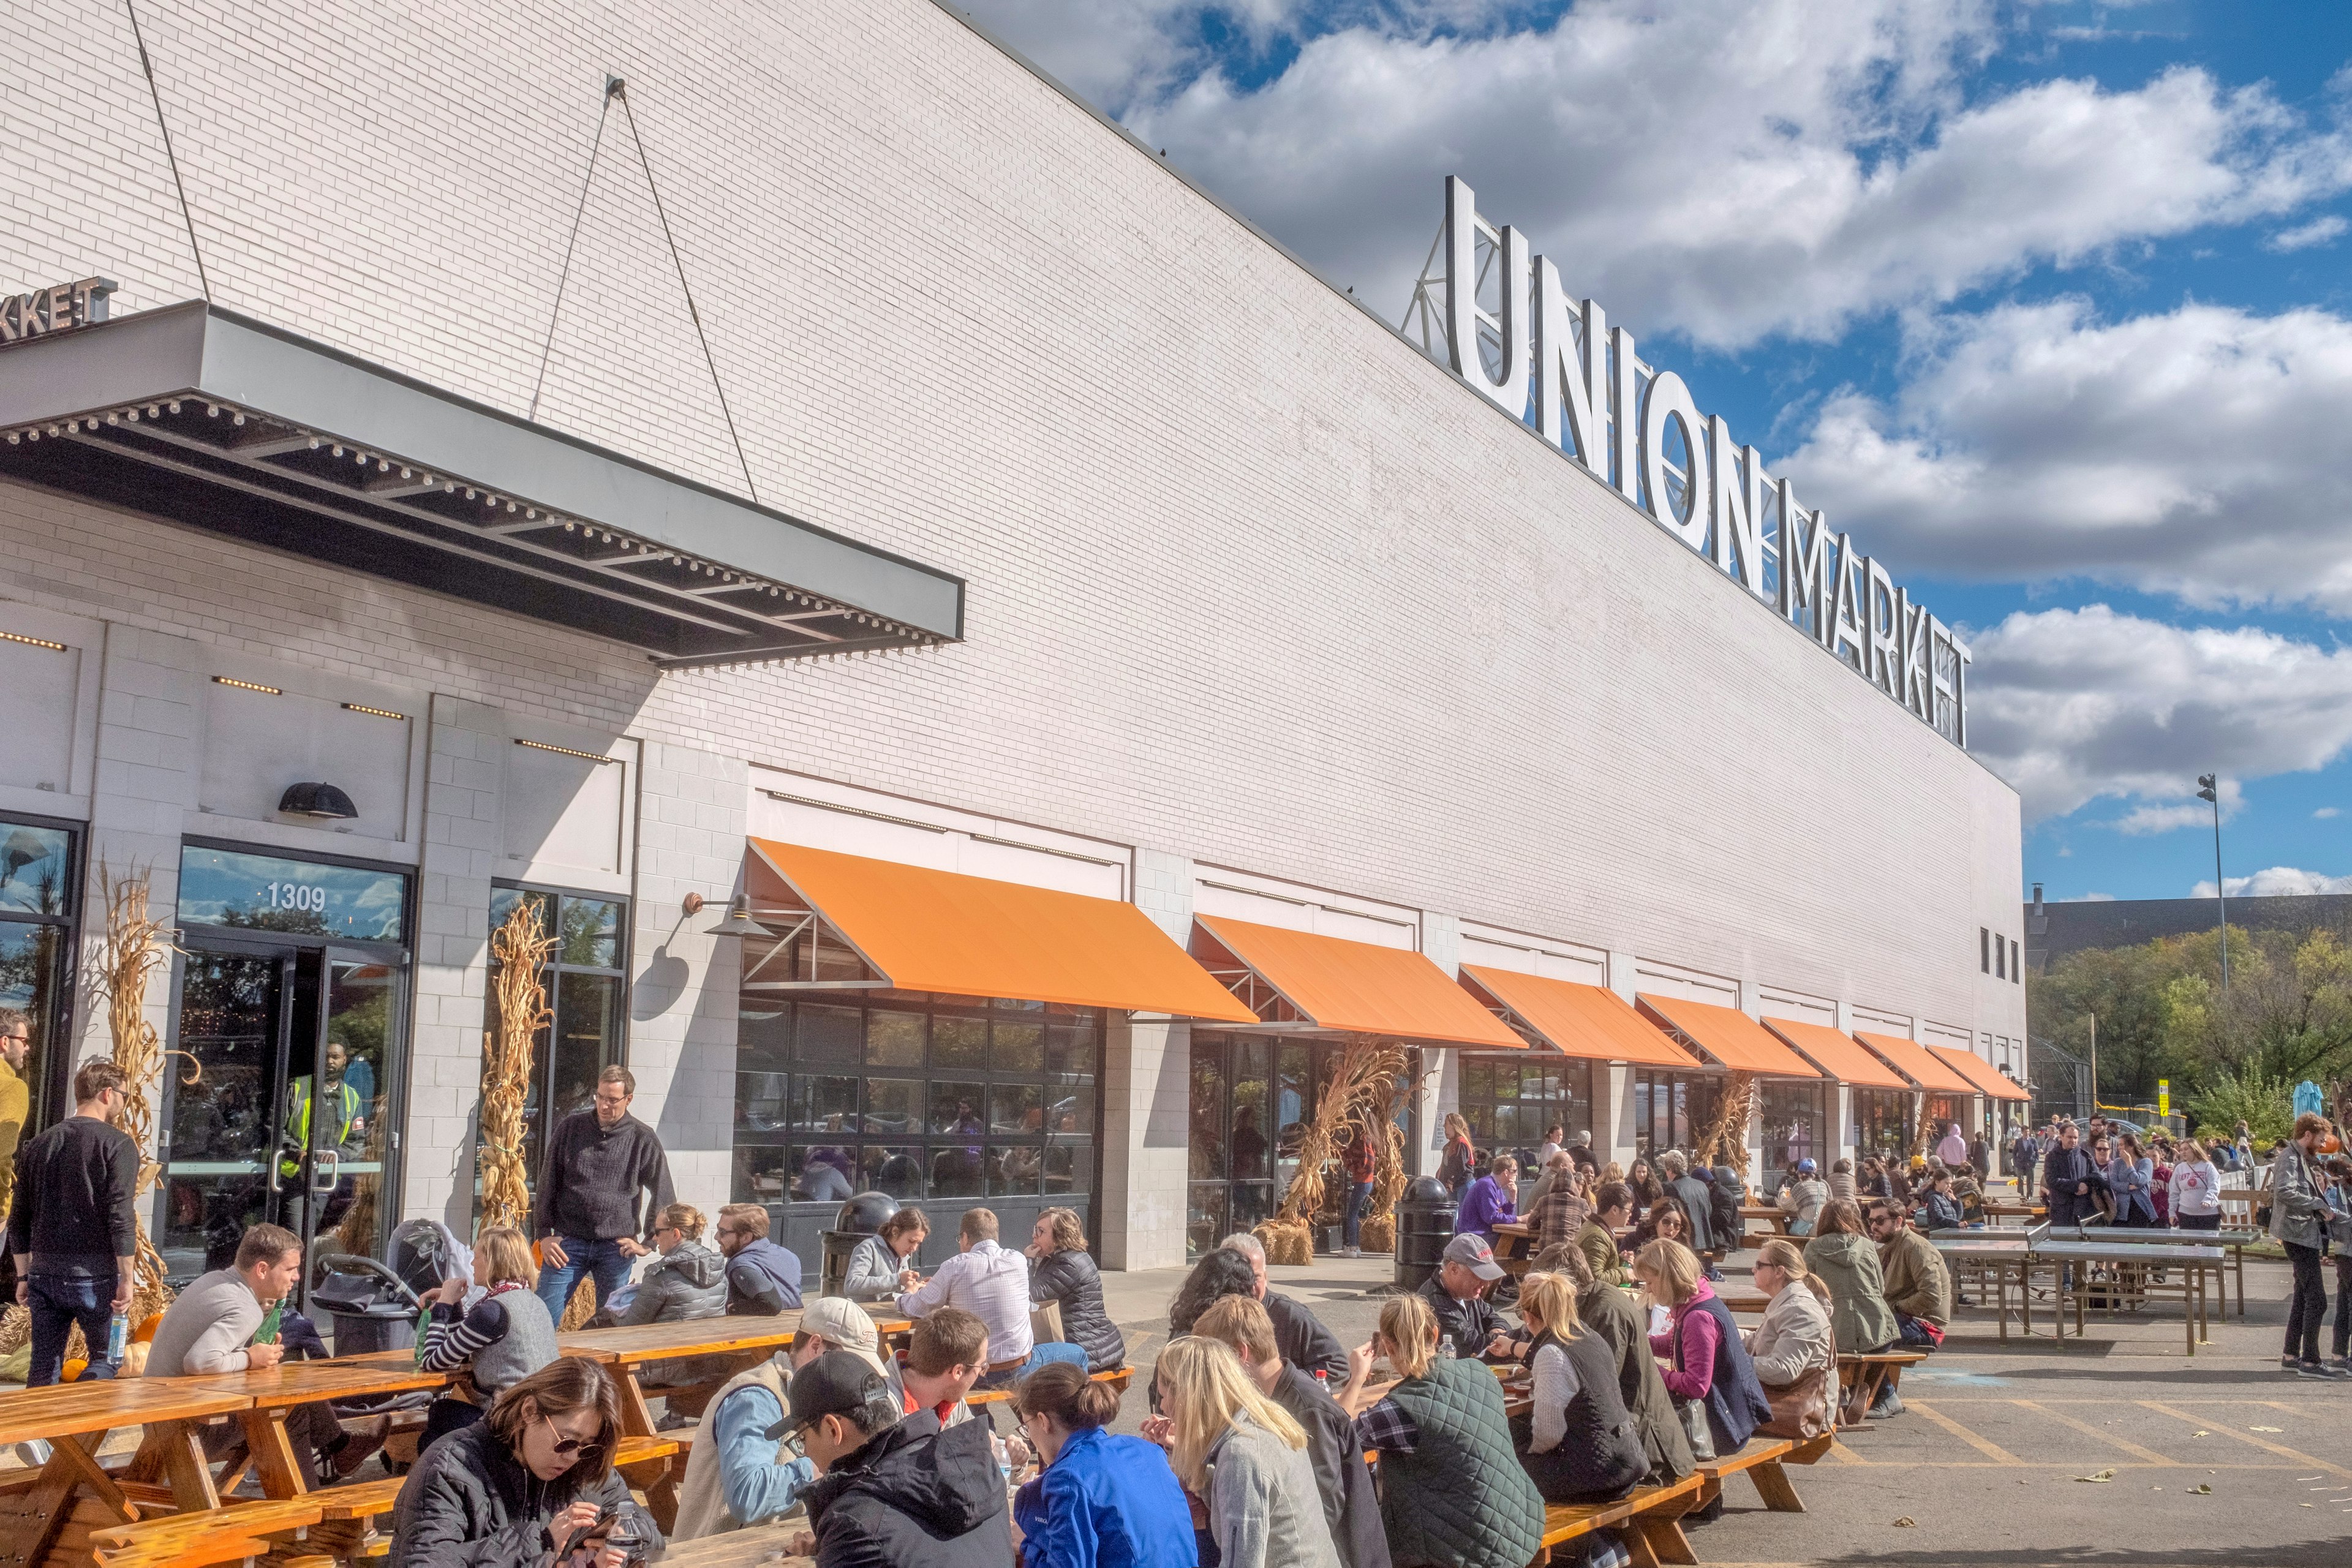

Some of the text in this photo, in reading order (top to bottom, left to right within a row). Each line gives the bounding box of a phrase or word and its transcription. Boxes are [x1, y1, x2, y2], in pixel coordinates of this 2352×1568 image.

[1446, 175, 1972, 749] UNION MARKET
[268, 882, 325, 912] 1309
